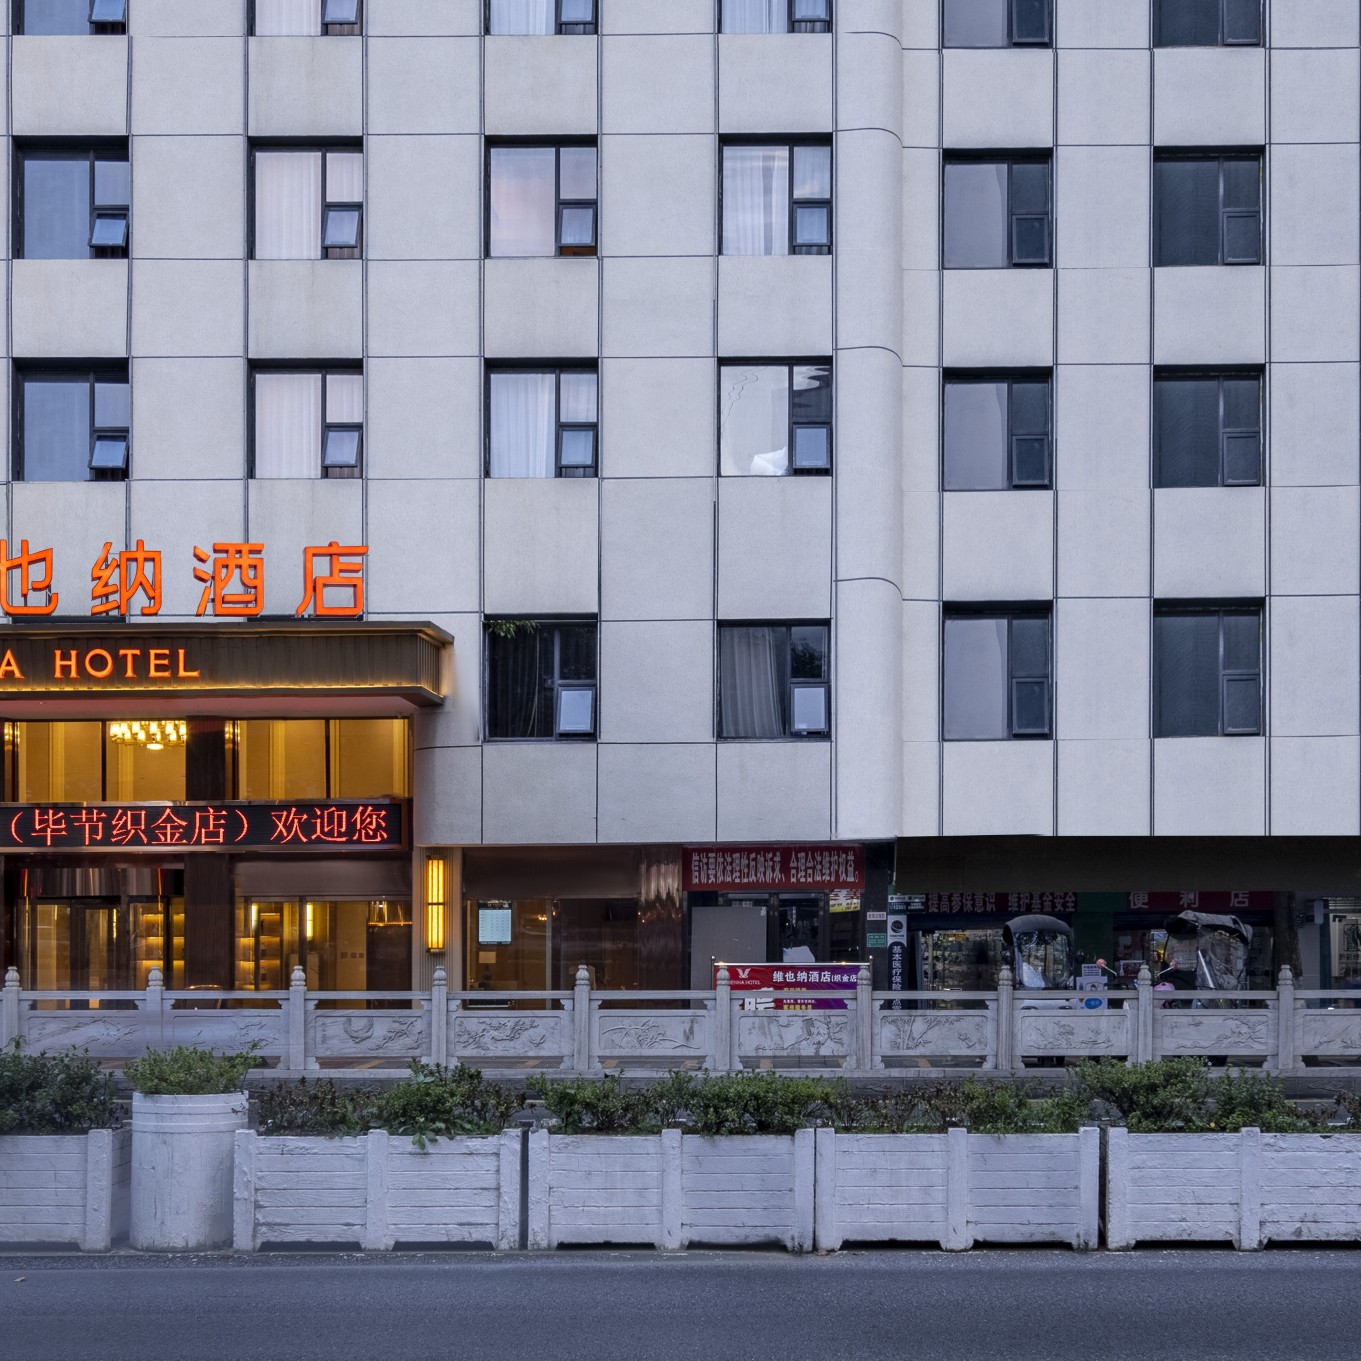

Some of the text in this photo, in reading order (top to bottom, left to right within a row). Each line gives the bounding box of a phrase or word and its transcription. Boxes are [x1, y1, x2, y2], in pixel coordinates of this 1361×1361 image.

[54, 647, 202, 680] HOTEL
[691, 851, 859, 884] 信访要依法理性反映诉求、合理合法维护权益。
[928, 892, 1077, 913] 提高参保意识 维护基金安全
[1128, 891, 1250, 909] 便利店
[772, 970, 858, 983] 维也纳酒店(织金店
